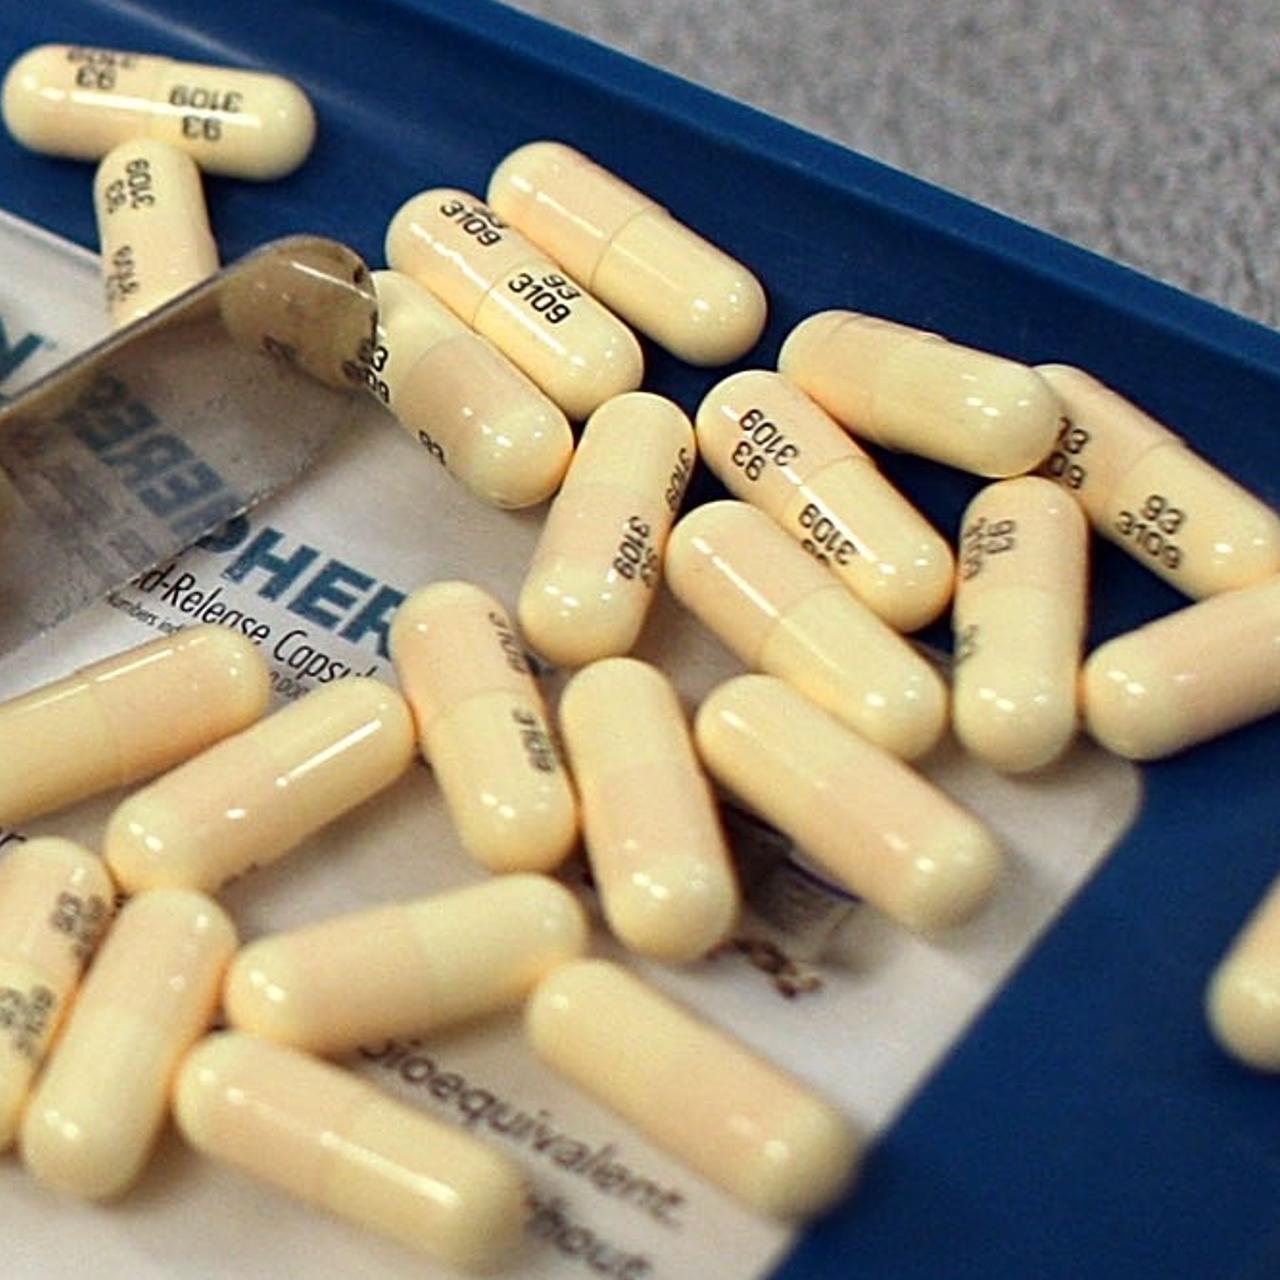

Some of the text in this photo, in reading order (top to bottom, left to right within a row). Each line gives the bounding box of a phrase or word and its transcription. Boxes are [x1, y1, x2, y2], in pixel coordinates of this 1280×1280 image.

[75, 65, 116, 91] 93
[168, 84, 243, 114] 3109
[181, 115, 223, 142] 93
[124, 157, 156, 211] 3109
[439, 199, 502, 247] 3109
[507, 271, 571, 325] 3109
[541, 272, 582, 301] 93
[731, 440, 766, 482] 93
[739, 408, 800, 467] 3109
[797, 503, 860, 566] 3109
[1143, 494, 1185, 535] 93
[613, 515, 651, 580] 3109
[1116, 510, 1182, 570] 3109
